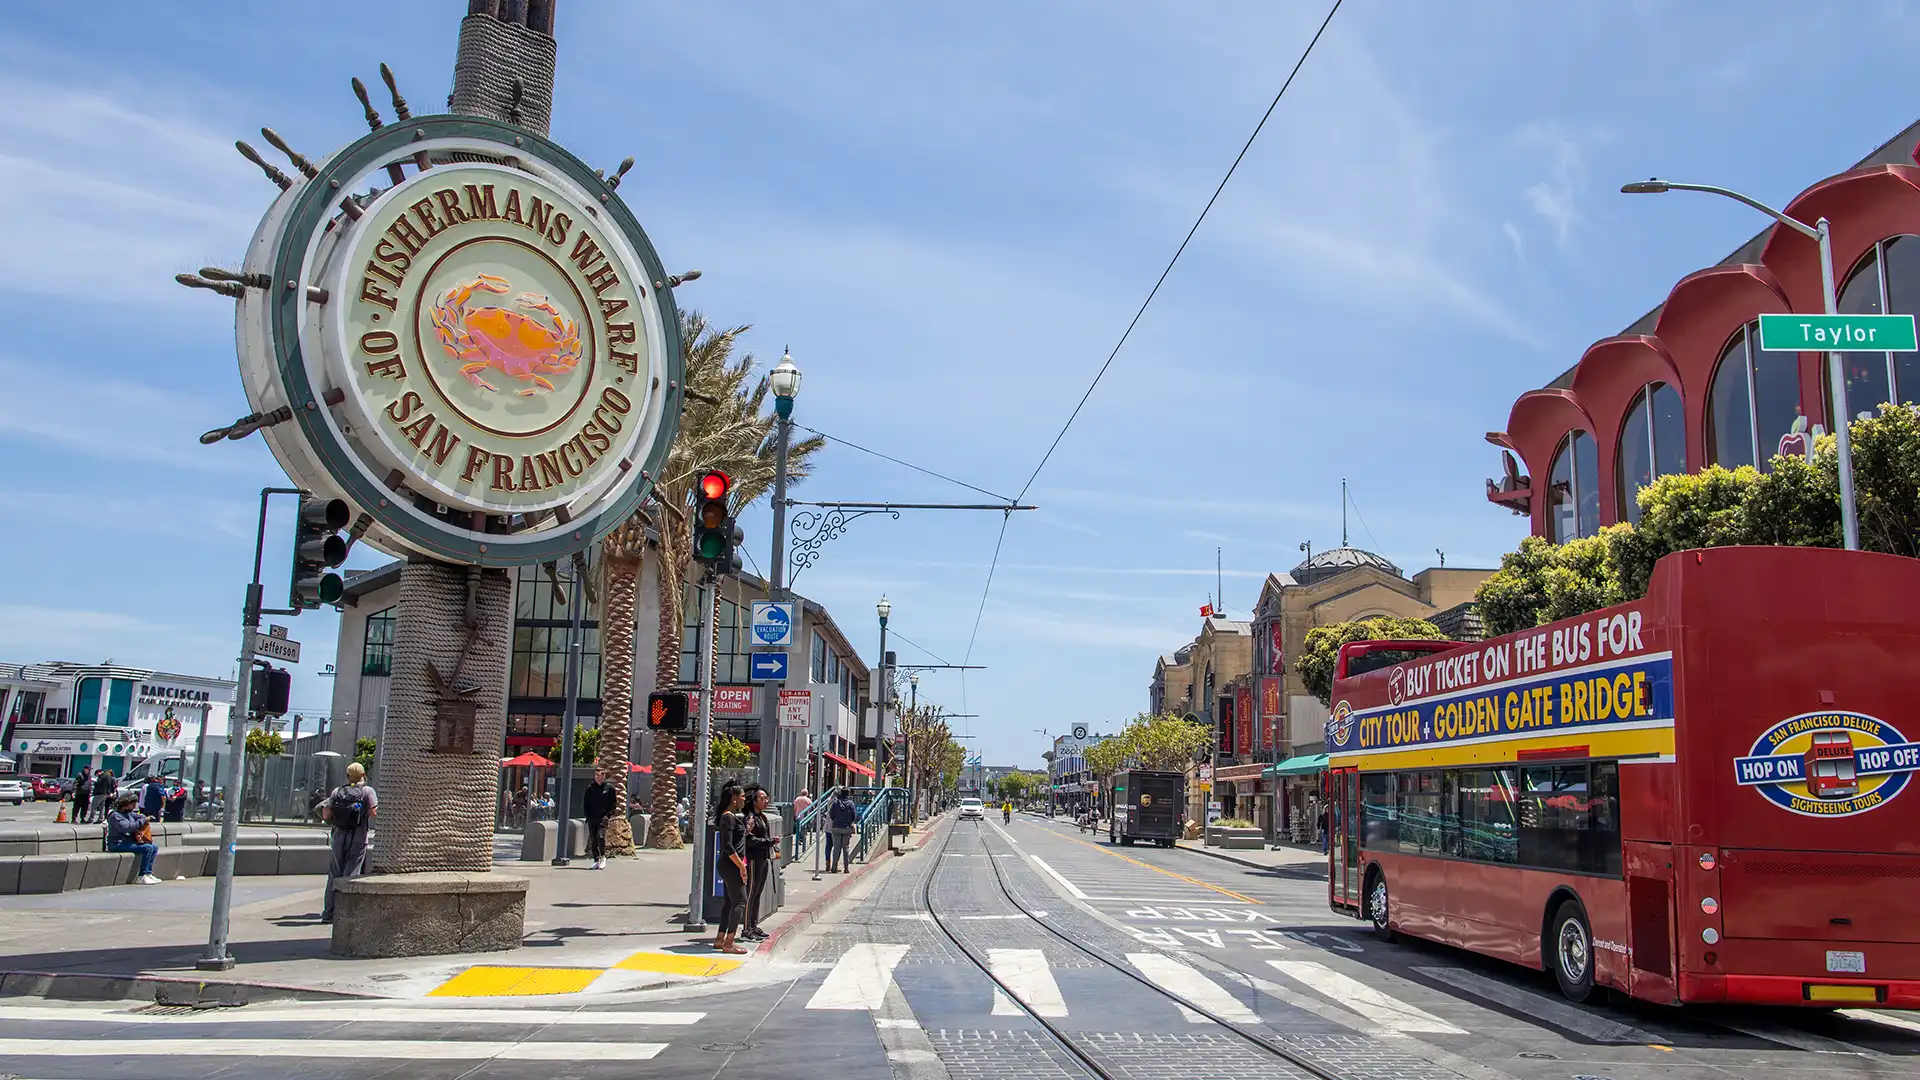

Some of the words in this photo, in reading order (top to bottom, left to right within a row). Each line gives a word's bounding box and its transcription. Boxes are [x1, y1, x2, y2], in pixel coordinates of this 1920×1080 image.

[360, 184, 573, 312] FISHERMANS
[568, 230, 638, 376] WHARF
[1799, 323, 1877, 345] Taylor
[360, 331, 408, 383] OF
[385, 390, 460, 467] SAN
[460, 386, 632, 493] FRANCISCO
[259, 640, 296, 658] Jefferson
[1407, 663, 1433, 697] BUY
[1435, 651, 1480, 691] TICKET
[1483, 643, 1510, 681] ON
[1515, 633, 1546, 673] THE
[1552, 622, 1591, 666] BUS
[1598, 611, 1644, 657] FOR
[717, 701, 742, 709] SEATING
[720, 690, 751, 701] OPEN
[780, 696, 789, 705] NO
[1359, 716, 1383, 747] CITY
[1386, 710, 1420, 745] TOUR
[1434, 695, 1499, 739] GOLDEN
[1505, 686, 1553, 730] GATE
[1560, 671, 1646, 724] BRIDGE
[1768, 727, 1788, 746] SAN
[1789, 715, 1841, 736] FRANCISCO
[1843, 716, 1881, 736] DELUXE
[1817, 747, 1850, 757] DELUXE
[1859, 751, 1893, 770] HOP
[1893, 748, 1919, 767] OFF
[1743, 761, 1774, 780] HOP
[1777, 759, 1799, 777] ON
[1790, 797, 1852, 814] SIGHTSEEING
[1852, 791, 1882, 810] TOURS
[1125, 905, 1281, 924] KEEP
